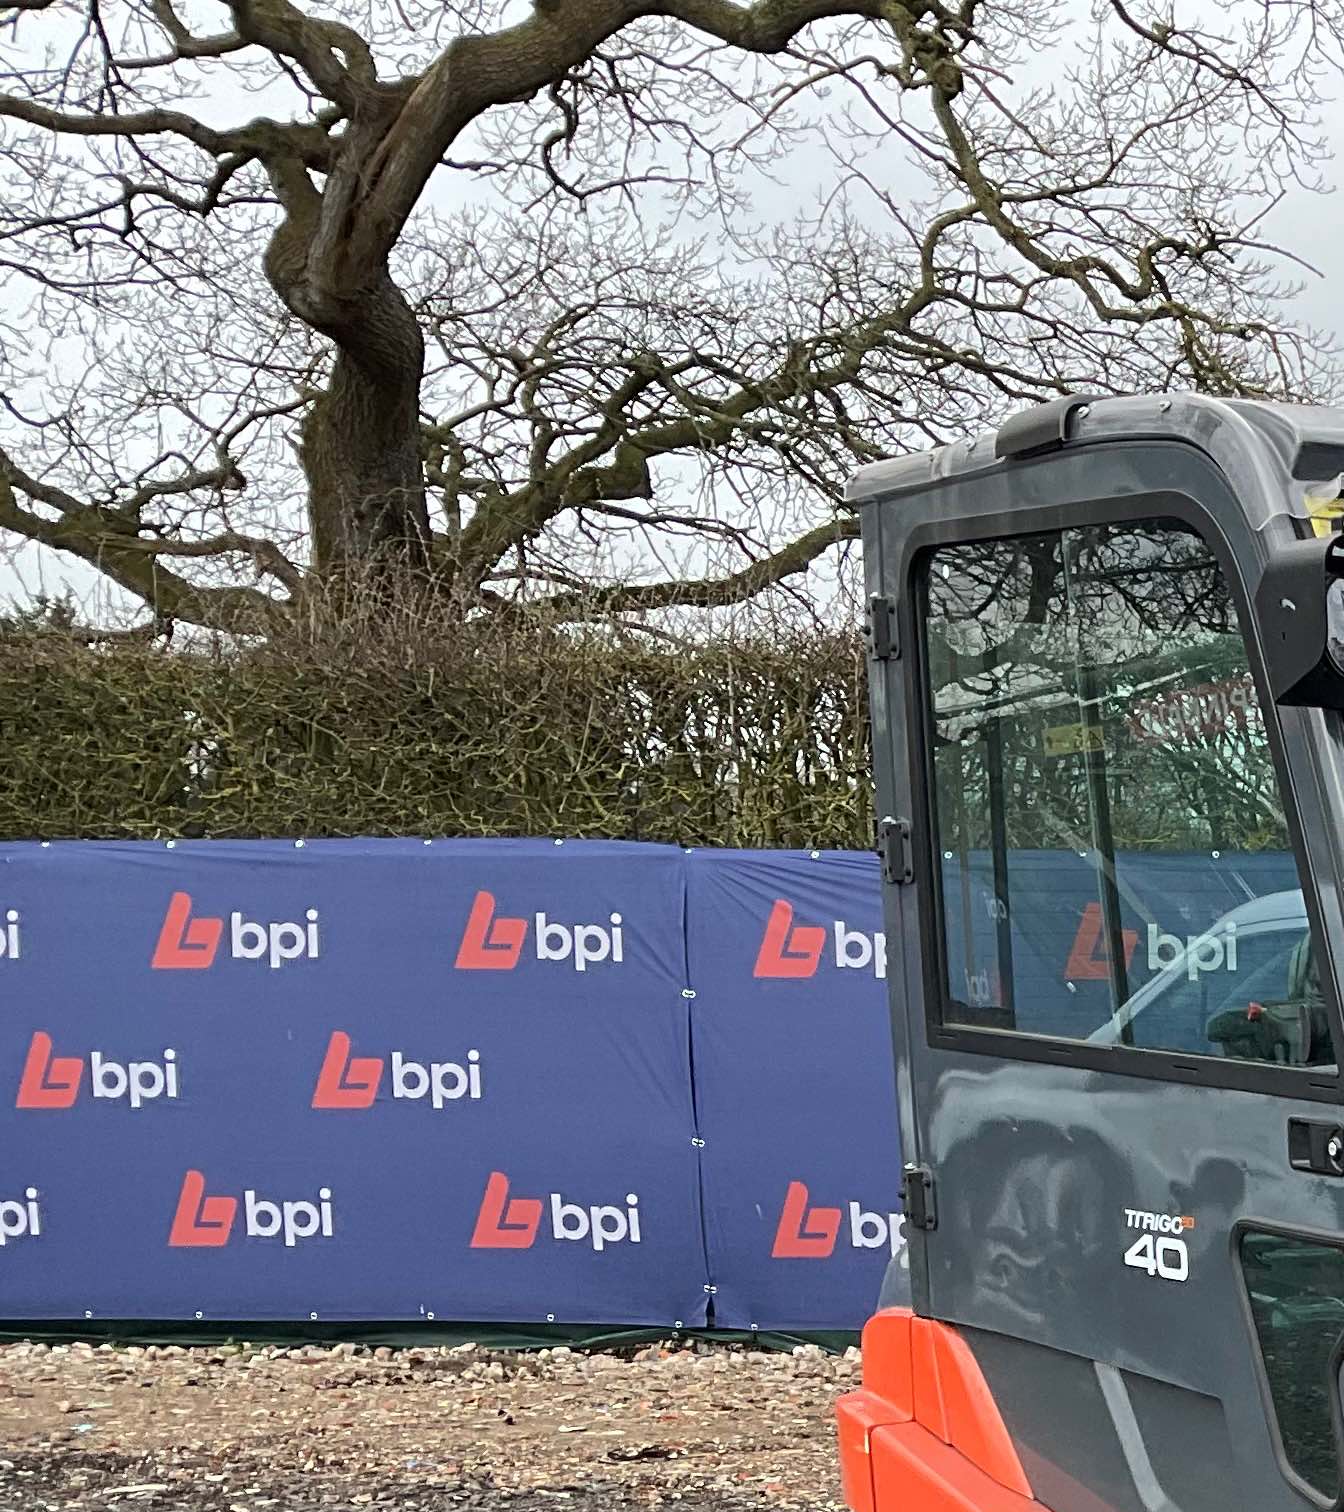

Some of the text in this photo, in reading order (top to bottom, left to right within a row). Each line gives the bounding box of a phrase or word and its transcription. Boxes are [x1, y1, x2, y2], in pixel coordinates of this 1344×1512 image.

[231, 908, 319, 969] bpi
[535, 912, 623, 972] bpi
[833, 920, 889, 979] bp
[1147, 921, 1237, 981] bpi
[90, 1048, 177, 1108] bpi
[391, 1049, 482, 1109] bpi
[0, 1187, 40, 1246] pi
[244, 1187, 333, 1247] bpi
[550, 1193, 641, 1251] bpi
[849, 1201, 907, 1258] bp
[1124, 1233, 1189, 1282] 40
